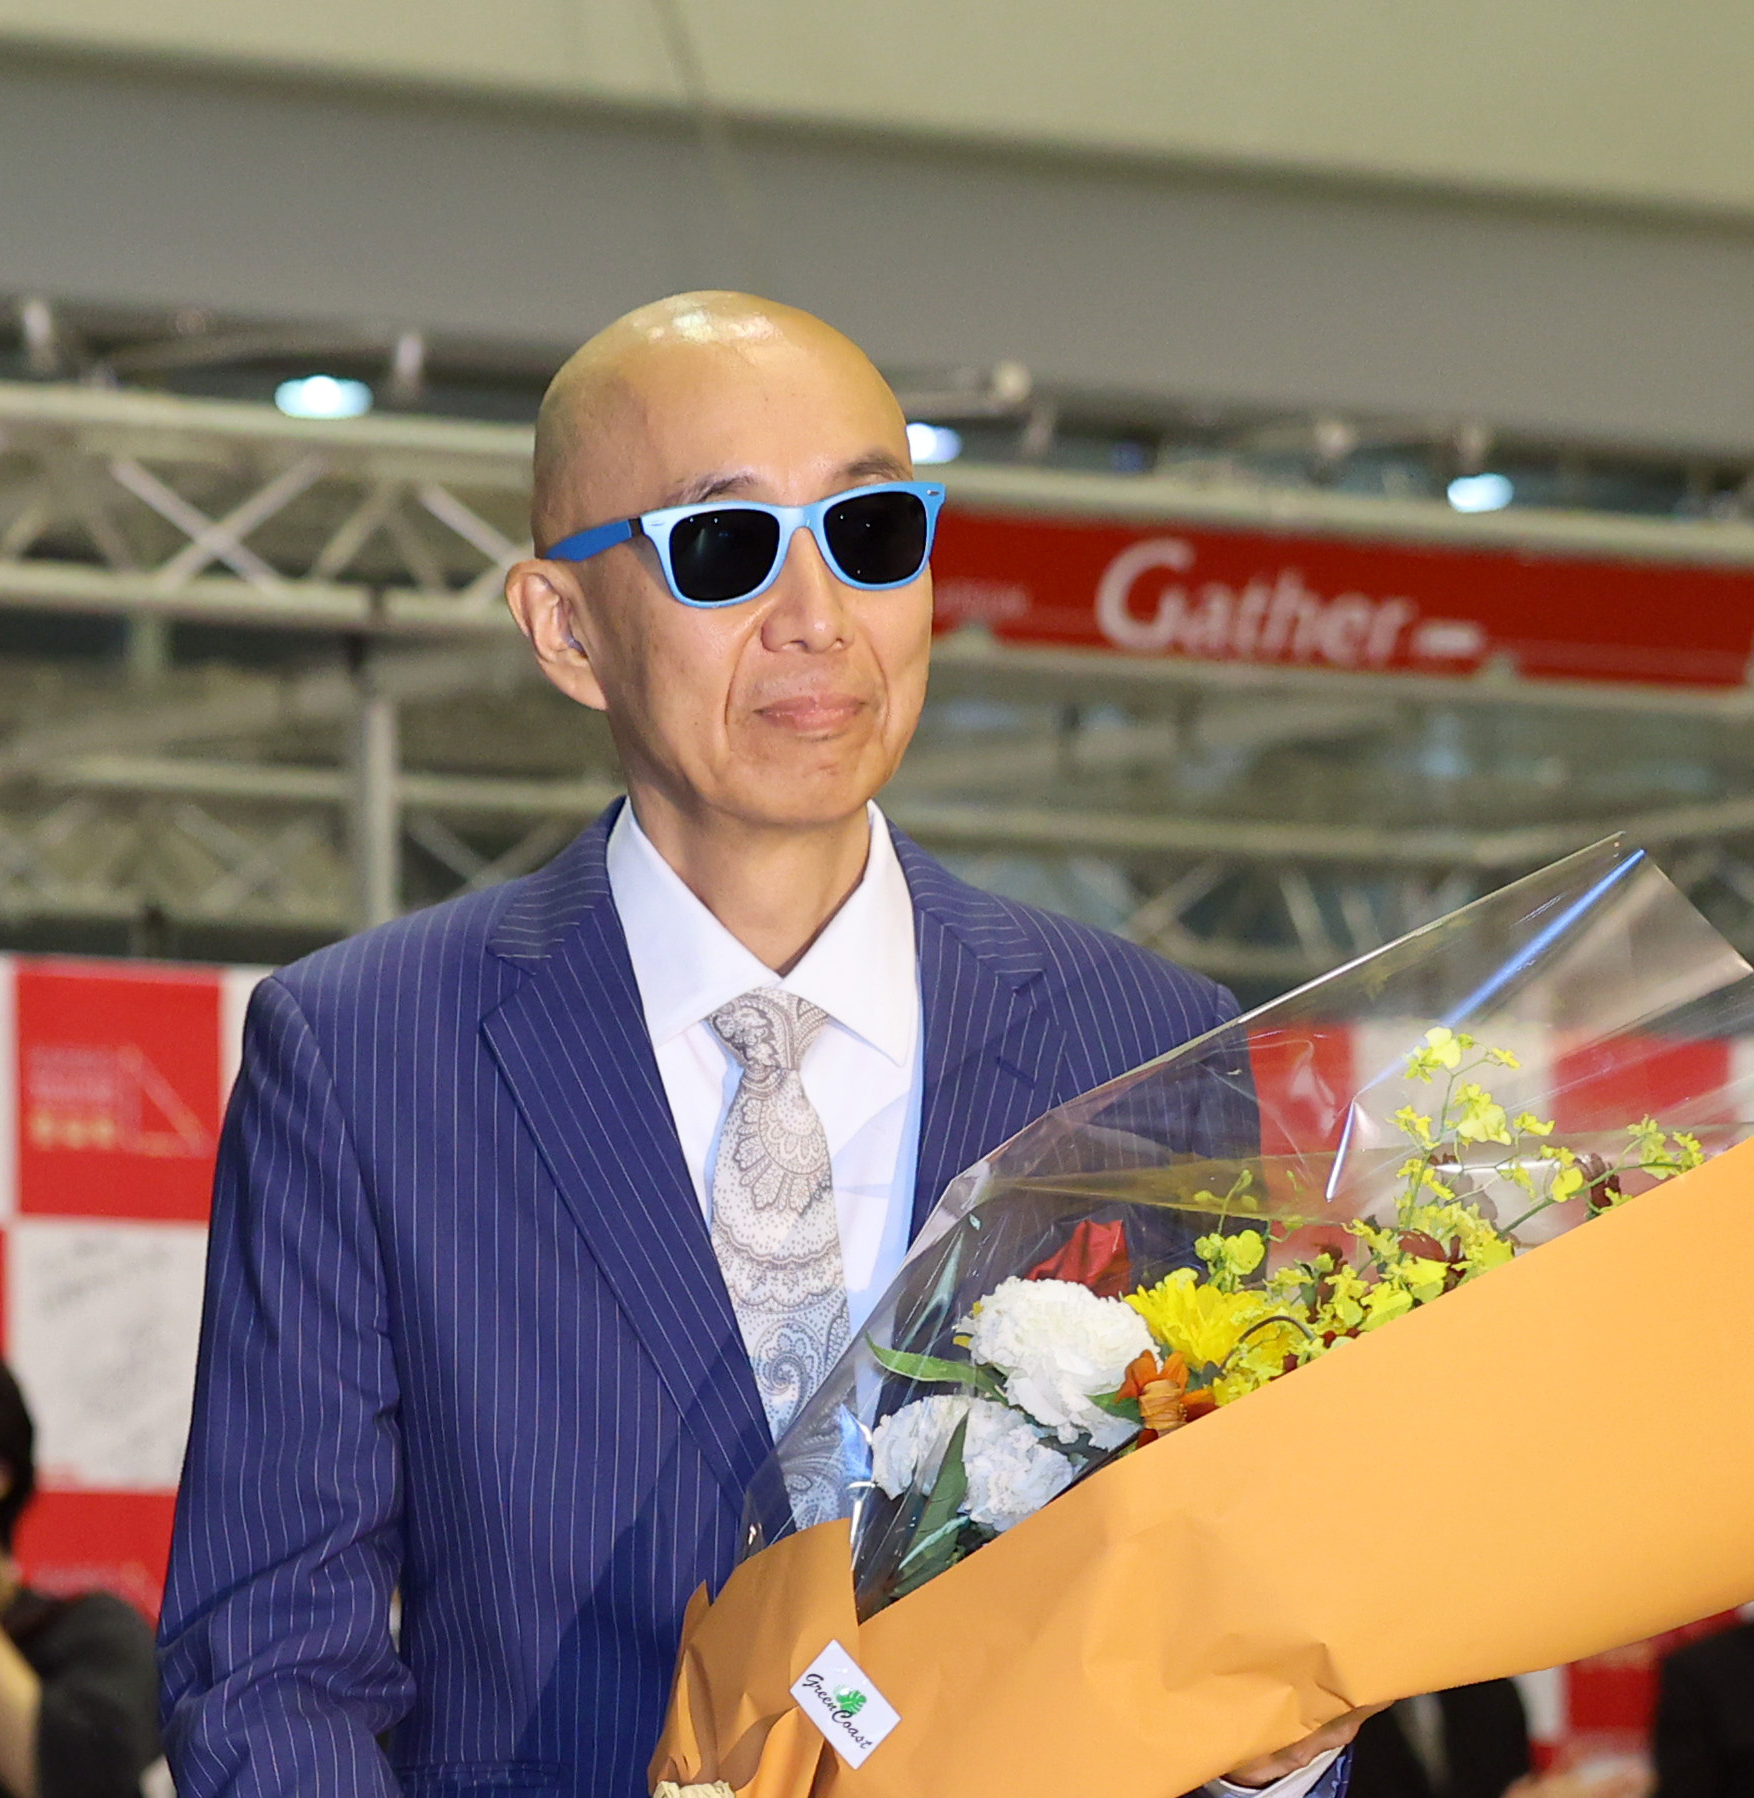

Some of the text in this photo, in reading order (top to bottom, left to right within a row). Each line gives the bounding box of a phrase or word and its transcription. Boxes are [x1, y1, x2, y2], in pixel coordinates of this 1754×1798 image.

[1095, 537, 1415, 665] Gather
[802, 1673, 873, 1750] Green Coast
